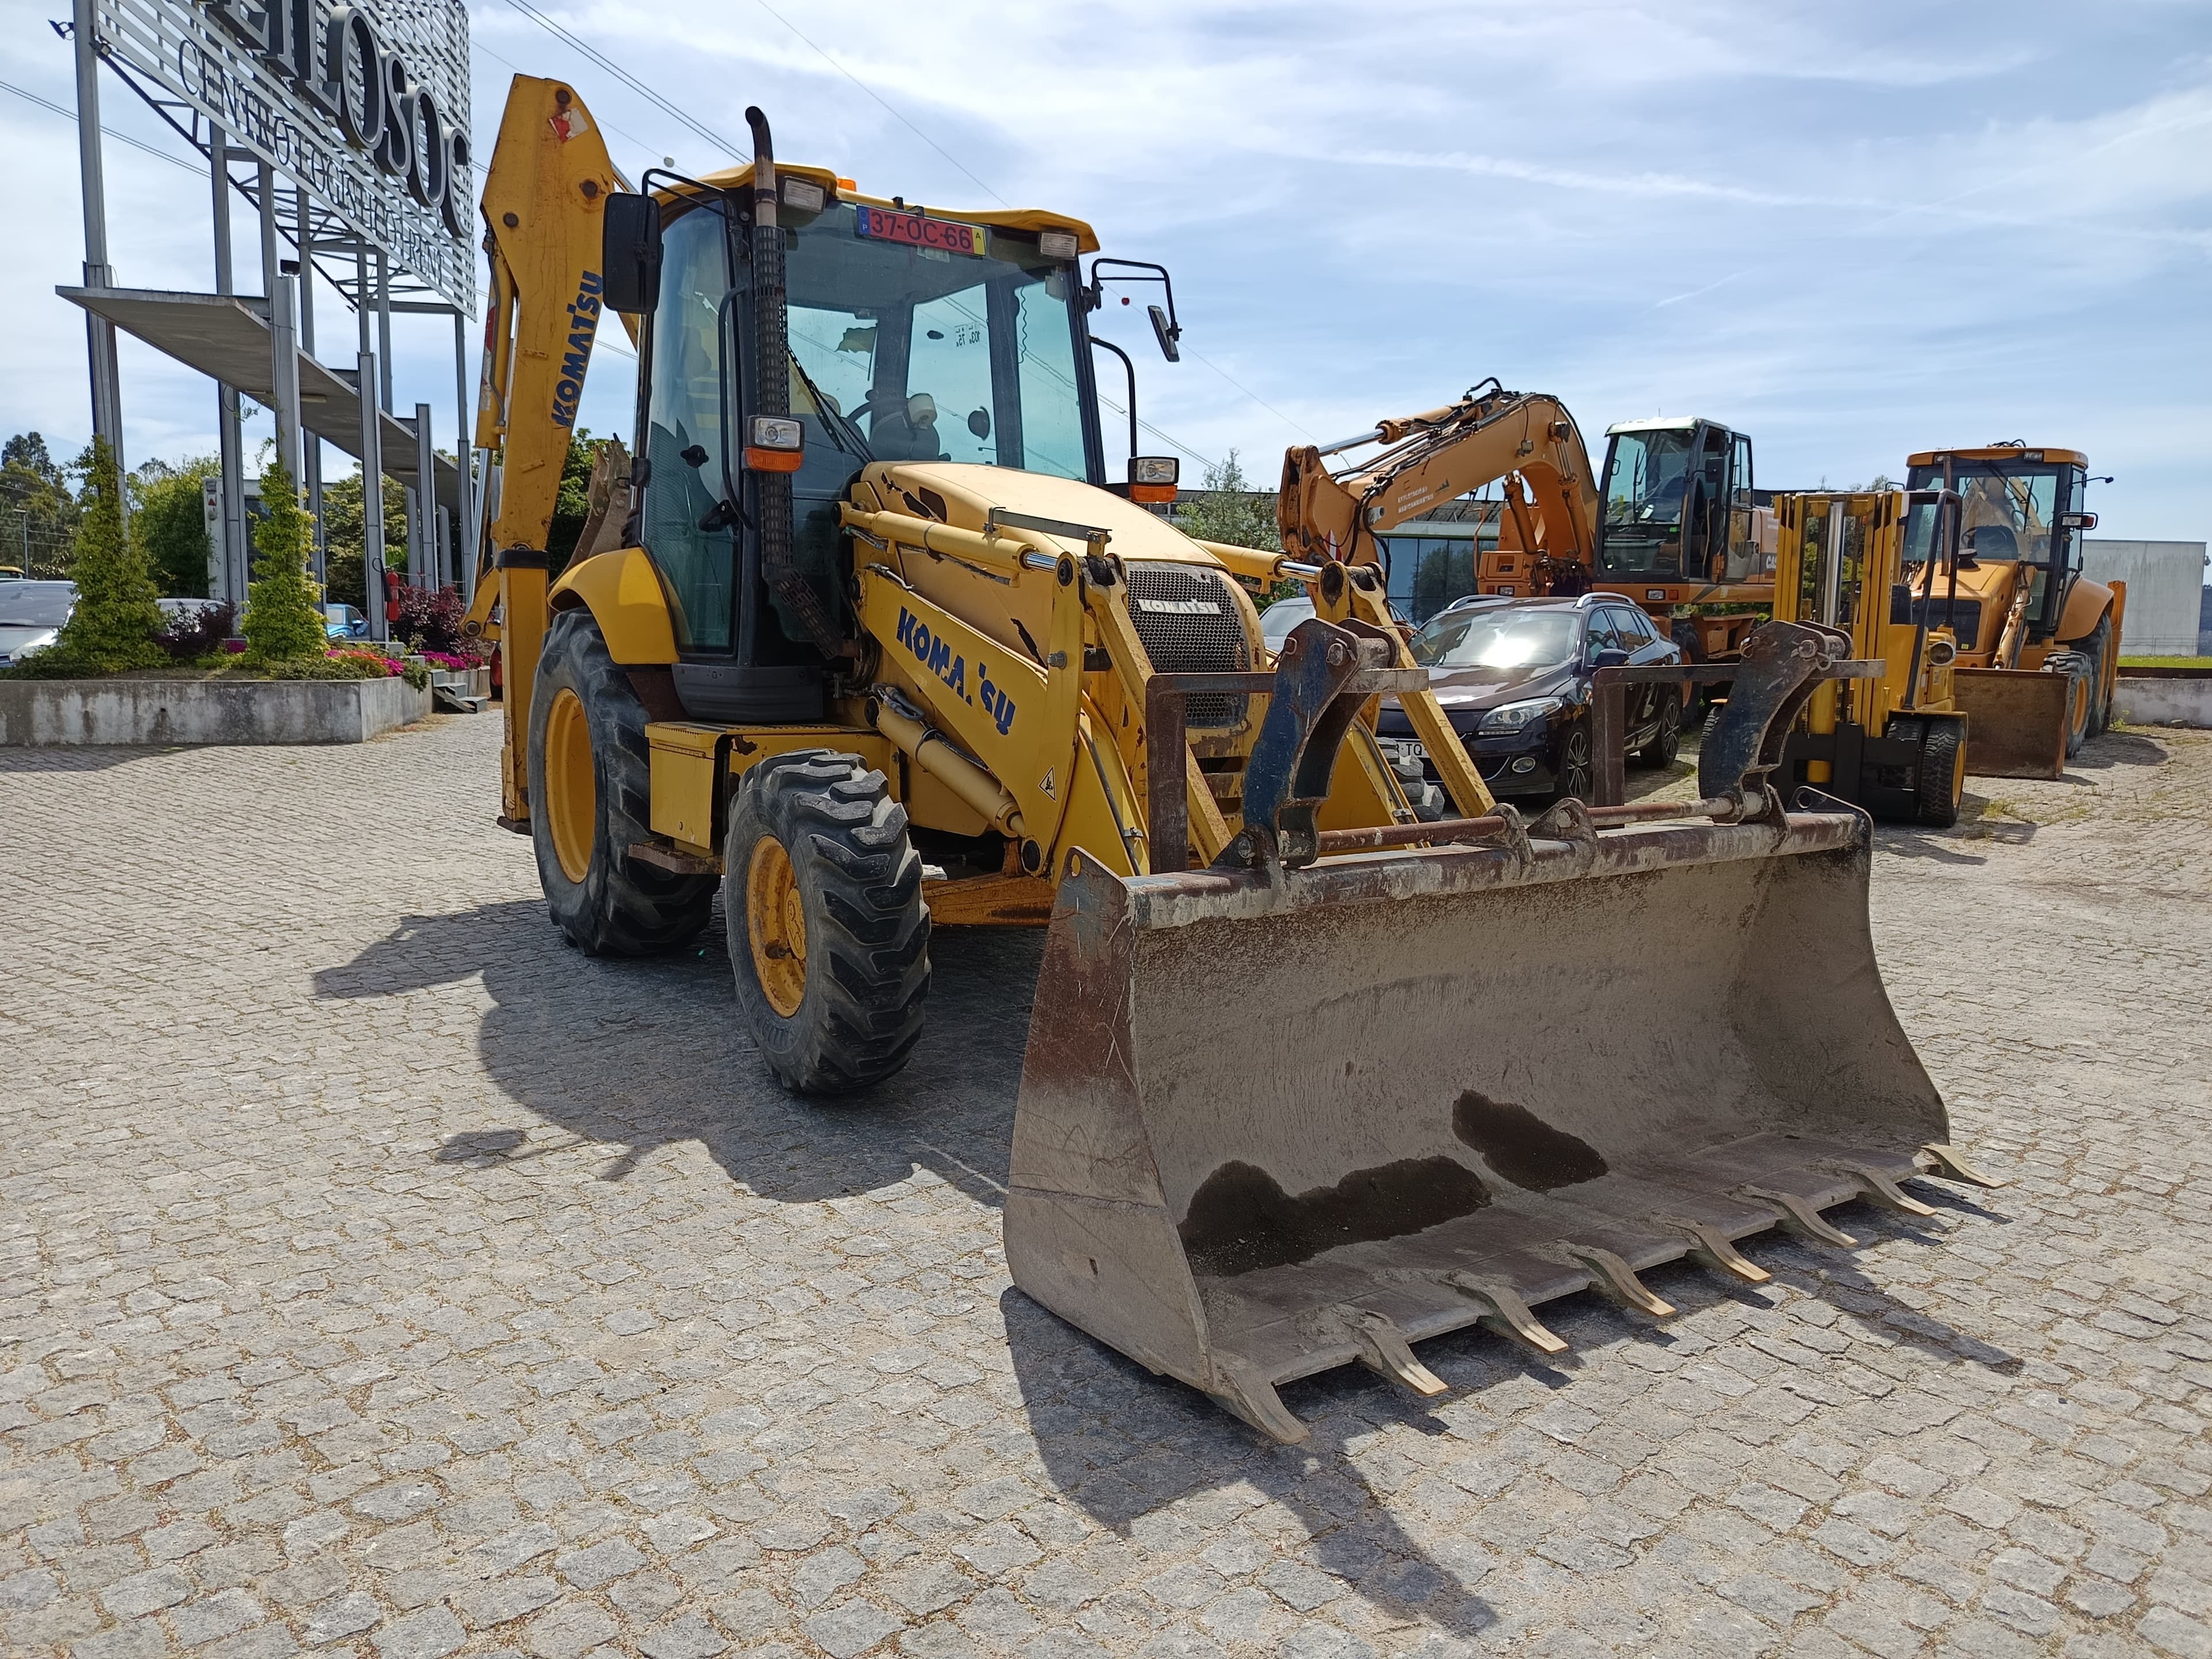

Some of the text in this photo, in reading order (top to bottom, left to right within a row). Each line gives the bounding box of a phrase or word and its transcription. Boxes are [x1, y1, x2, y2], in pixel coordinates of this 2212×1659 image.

[179, 39, 290, 166] CENTRO
[551, 270, 603, 427] KOMATSU
[896, 605, 1016, 736] KOMASU
[1138, 599, 1221, 615] KOMATSU
